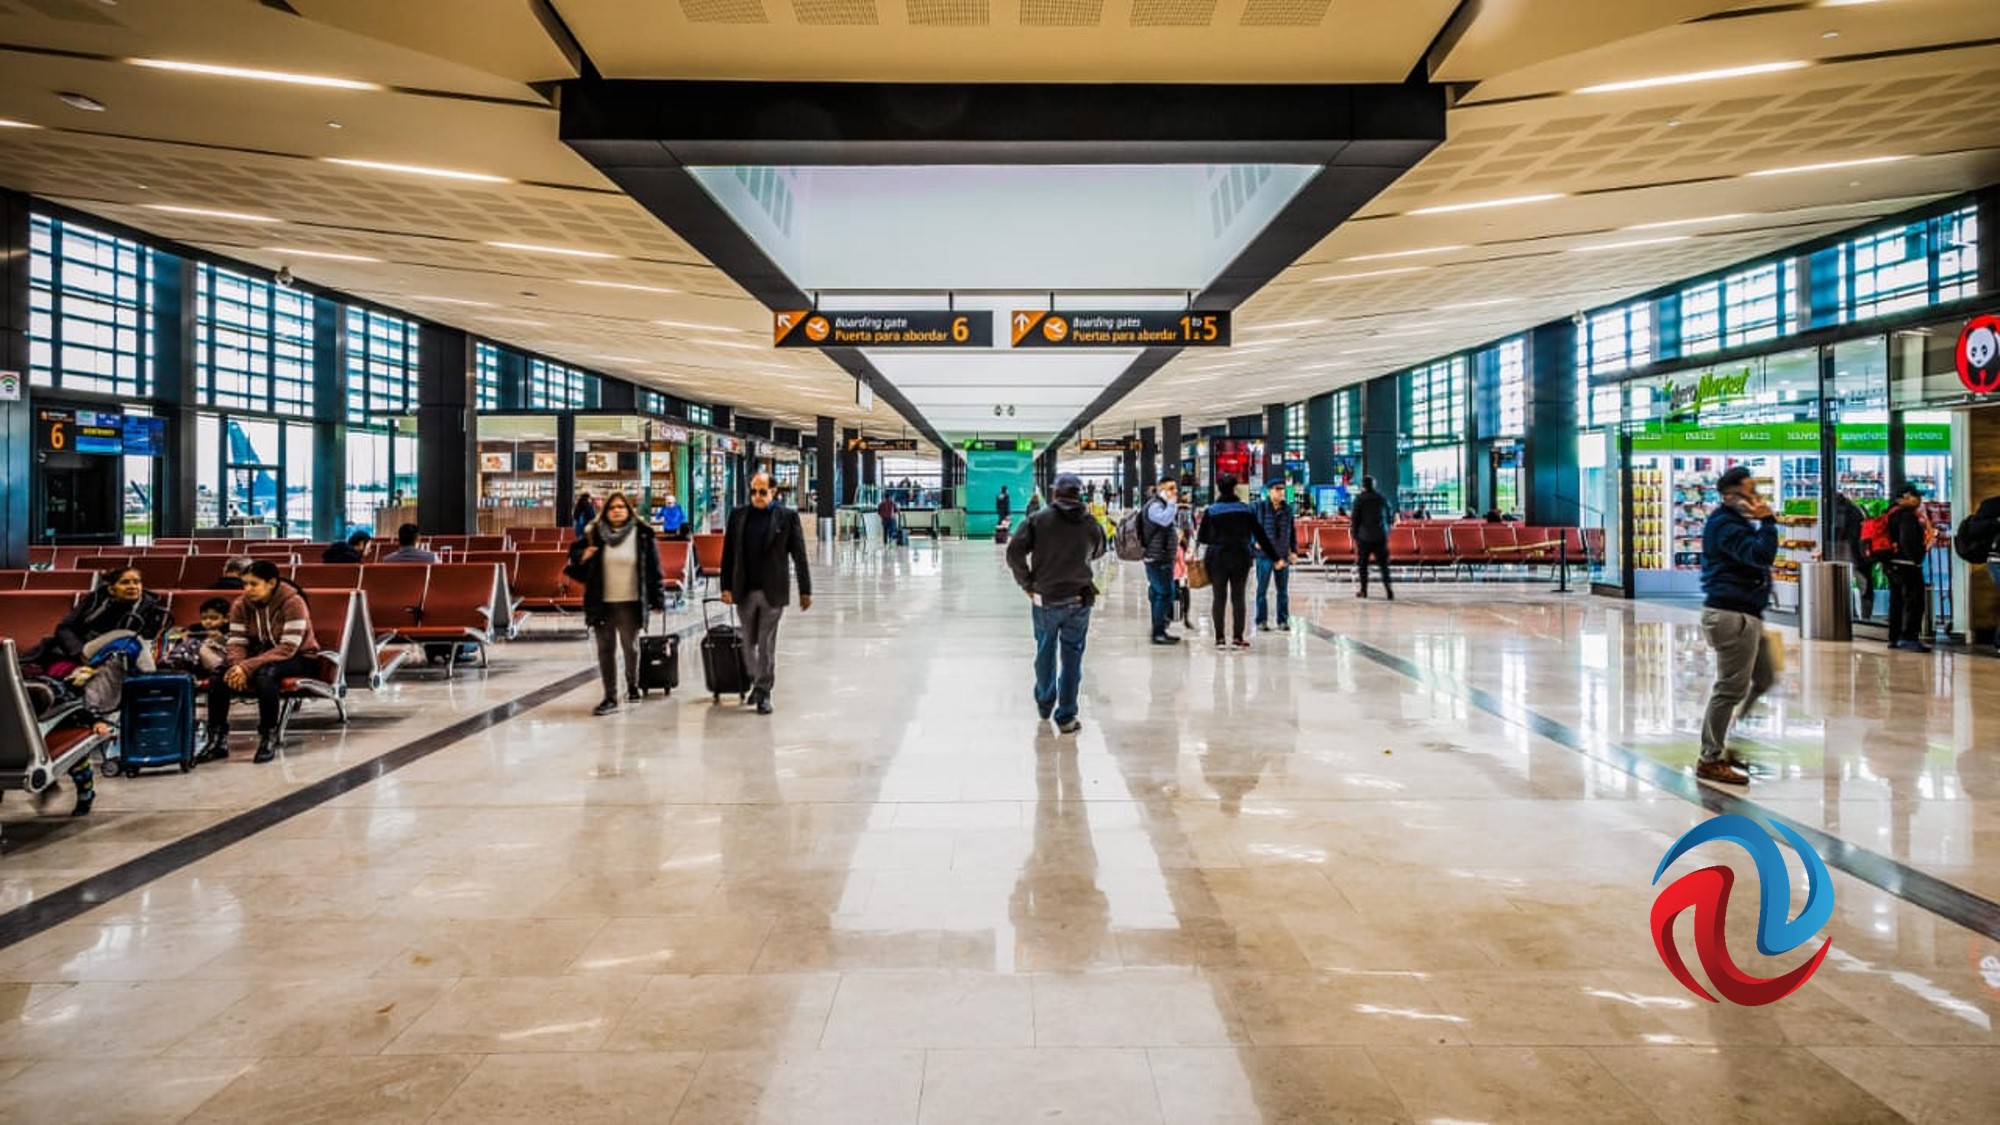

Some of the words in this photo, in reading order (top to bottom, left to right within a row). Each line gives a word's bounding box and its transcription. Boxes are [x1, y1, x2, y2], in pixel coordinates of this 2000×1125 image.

[835, 317, 881, 330] Boarding
[884, 318, 908, 330] gate
[952, 316, 970, 342] 6
[1073, 317, 1114, 330] Boarding
[1116, 317, 1141, 330] gates
[1180, 315, 1191, 340] 1
[1203, 316, 1218, 341] 5
[835, 330, 872, 341] Puerta
[874, 331, 900, 343] para
[903, 329, 948, 341] abordar
[1073, 330, 1110, 341] Puertas
[1112, 331, 1135, 343] para
[1137, 329, 1177, 341] abordar
[51, 422, 64, 449] 6
[1787, 431, 1821, 440] SOUVEN
